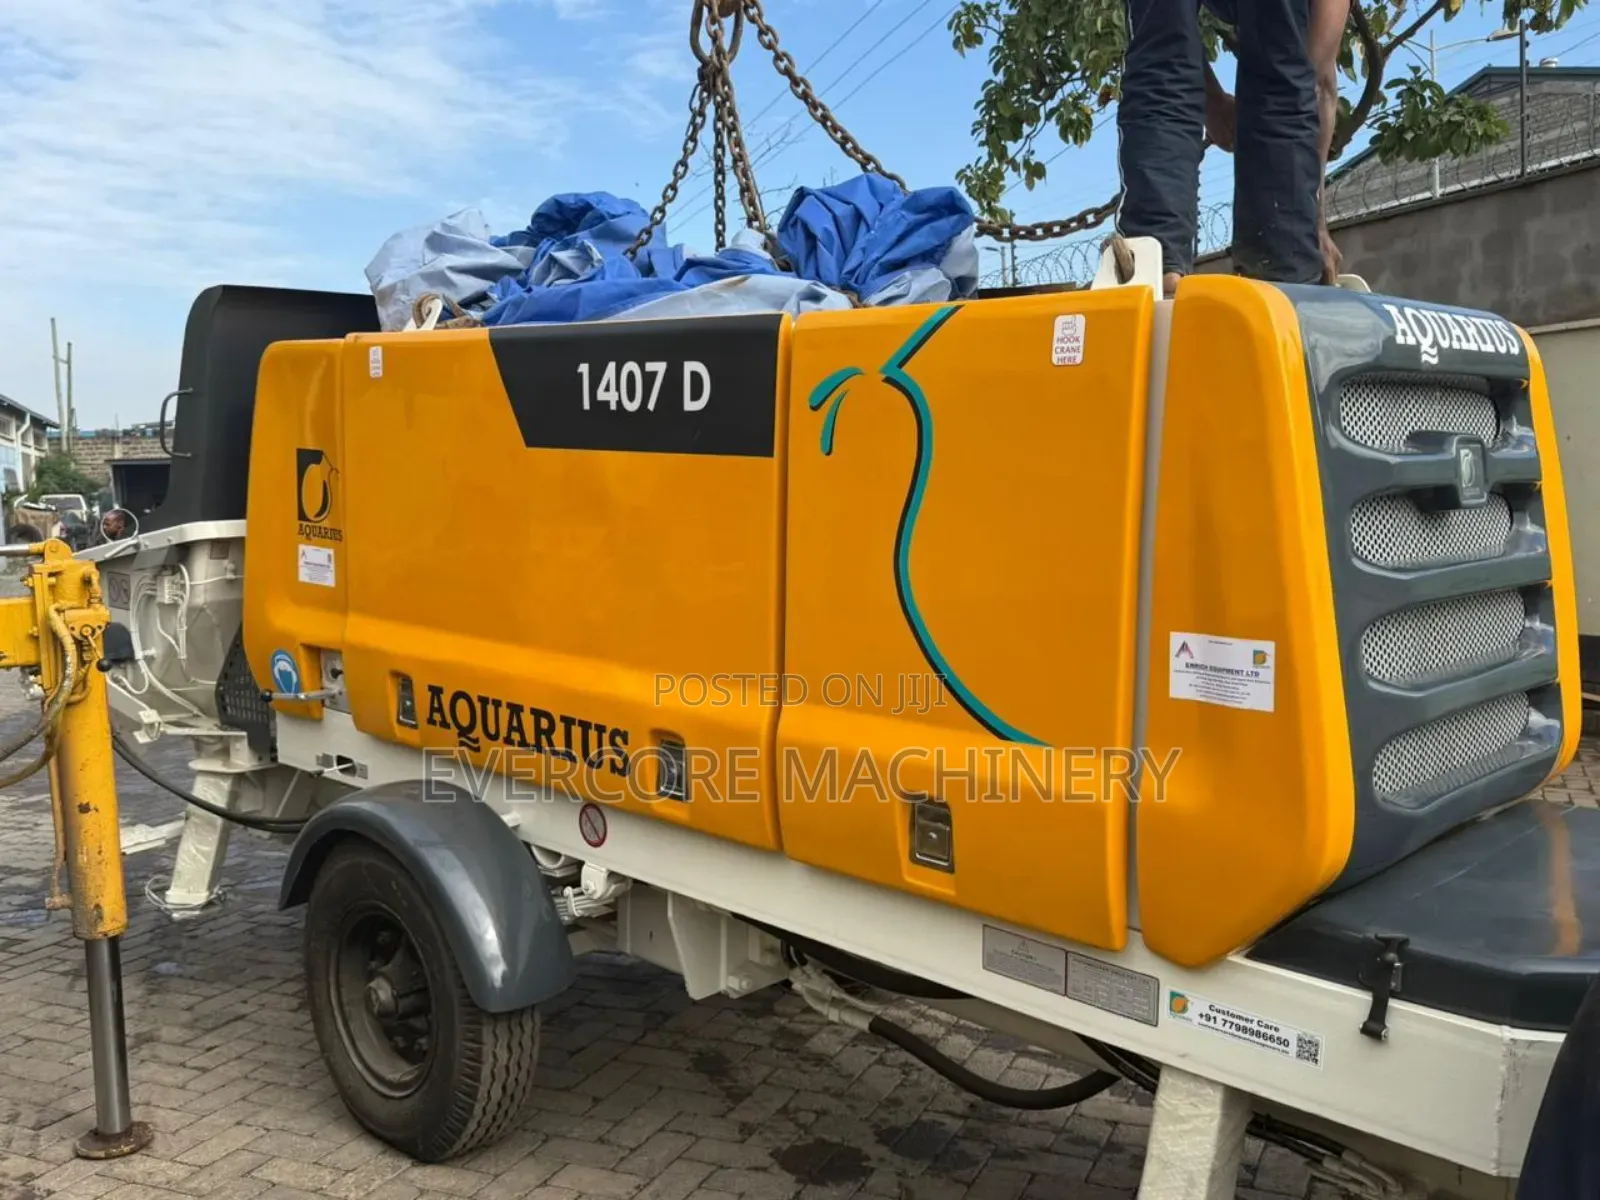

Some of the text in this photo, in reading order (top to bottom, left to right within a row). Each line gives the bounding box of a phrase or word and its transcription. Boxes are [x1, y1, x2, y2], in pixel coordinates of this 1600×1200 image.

[1056, 335, 1081, 345] HOOK
[1381, 303, 1520, 365] AQUARIUS
[1054, 345, 1081, 355] CRANE
[1056, 356, 1077, 365] HERE
[576, 360, 711, 412] 1407 D
[297, 523, 343, 542] AQUARIUS
[426, 684, 632, 778] AQUARIUS
[1198, 1012, 1218, 1025] +91
[1221, 1018, 1291, 1048] 7798986650
[1208, 1003, 1254, 1025] Customer
[1256, 1019, 1281, 1033] Care
